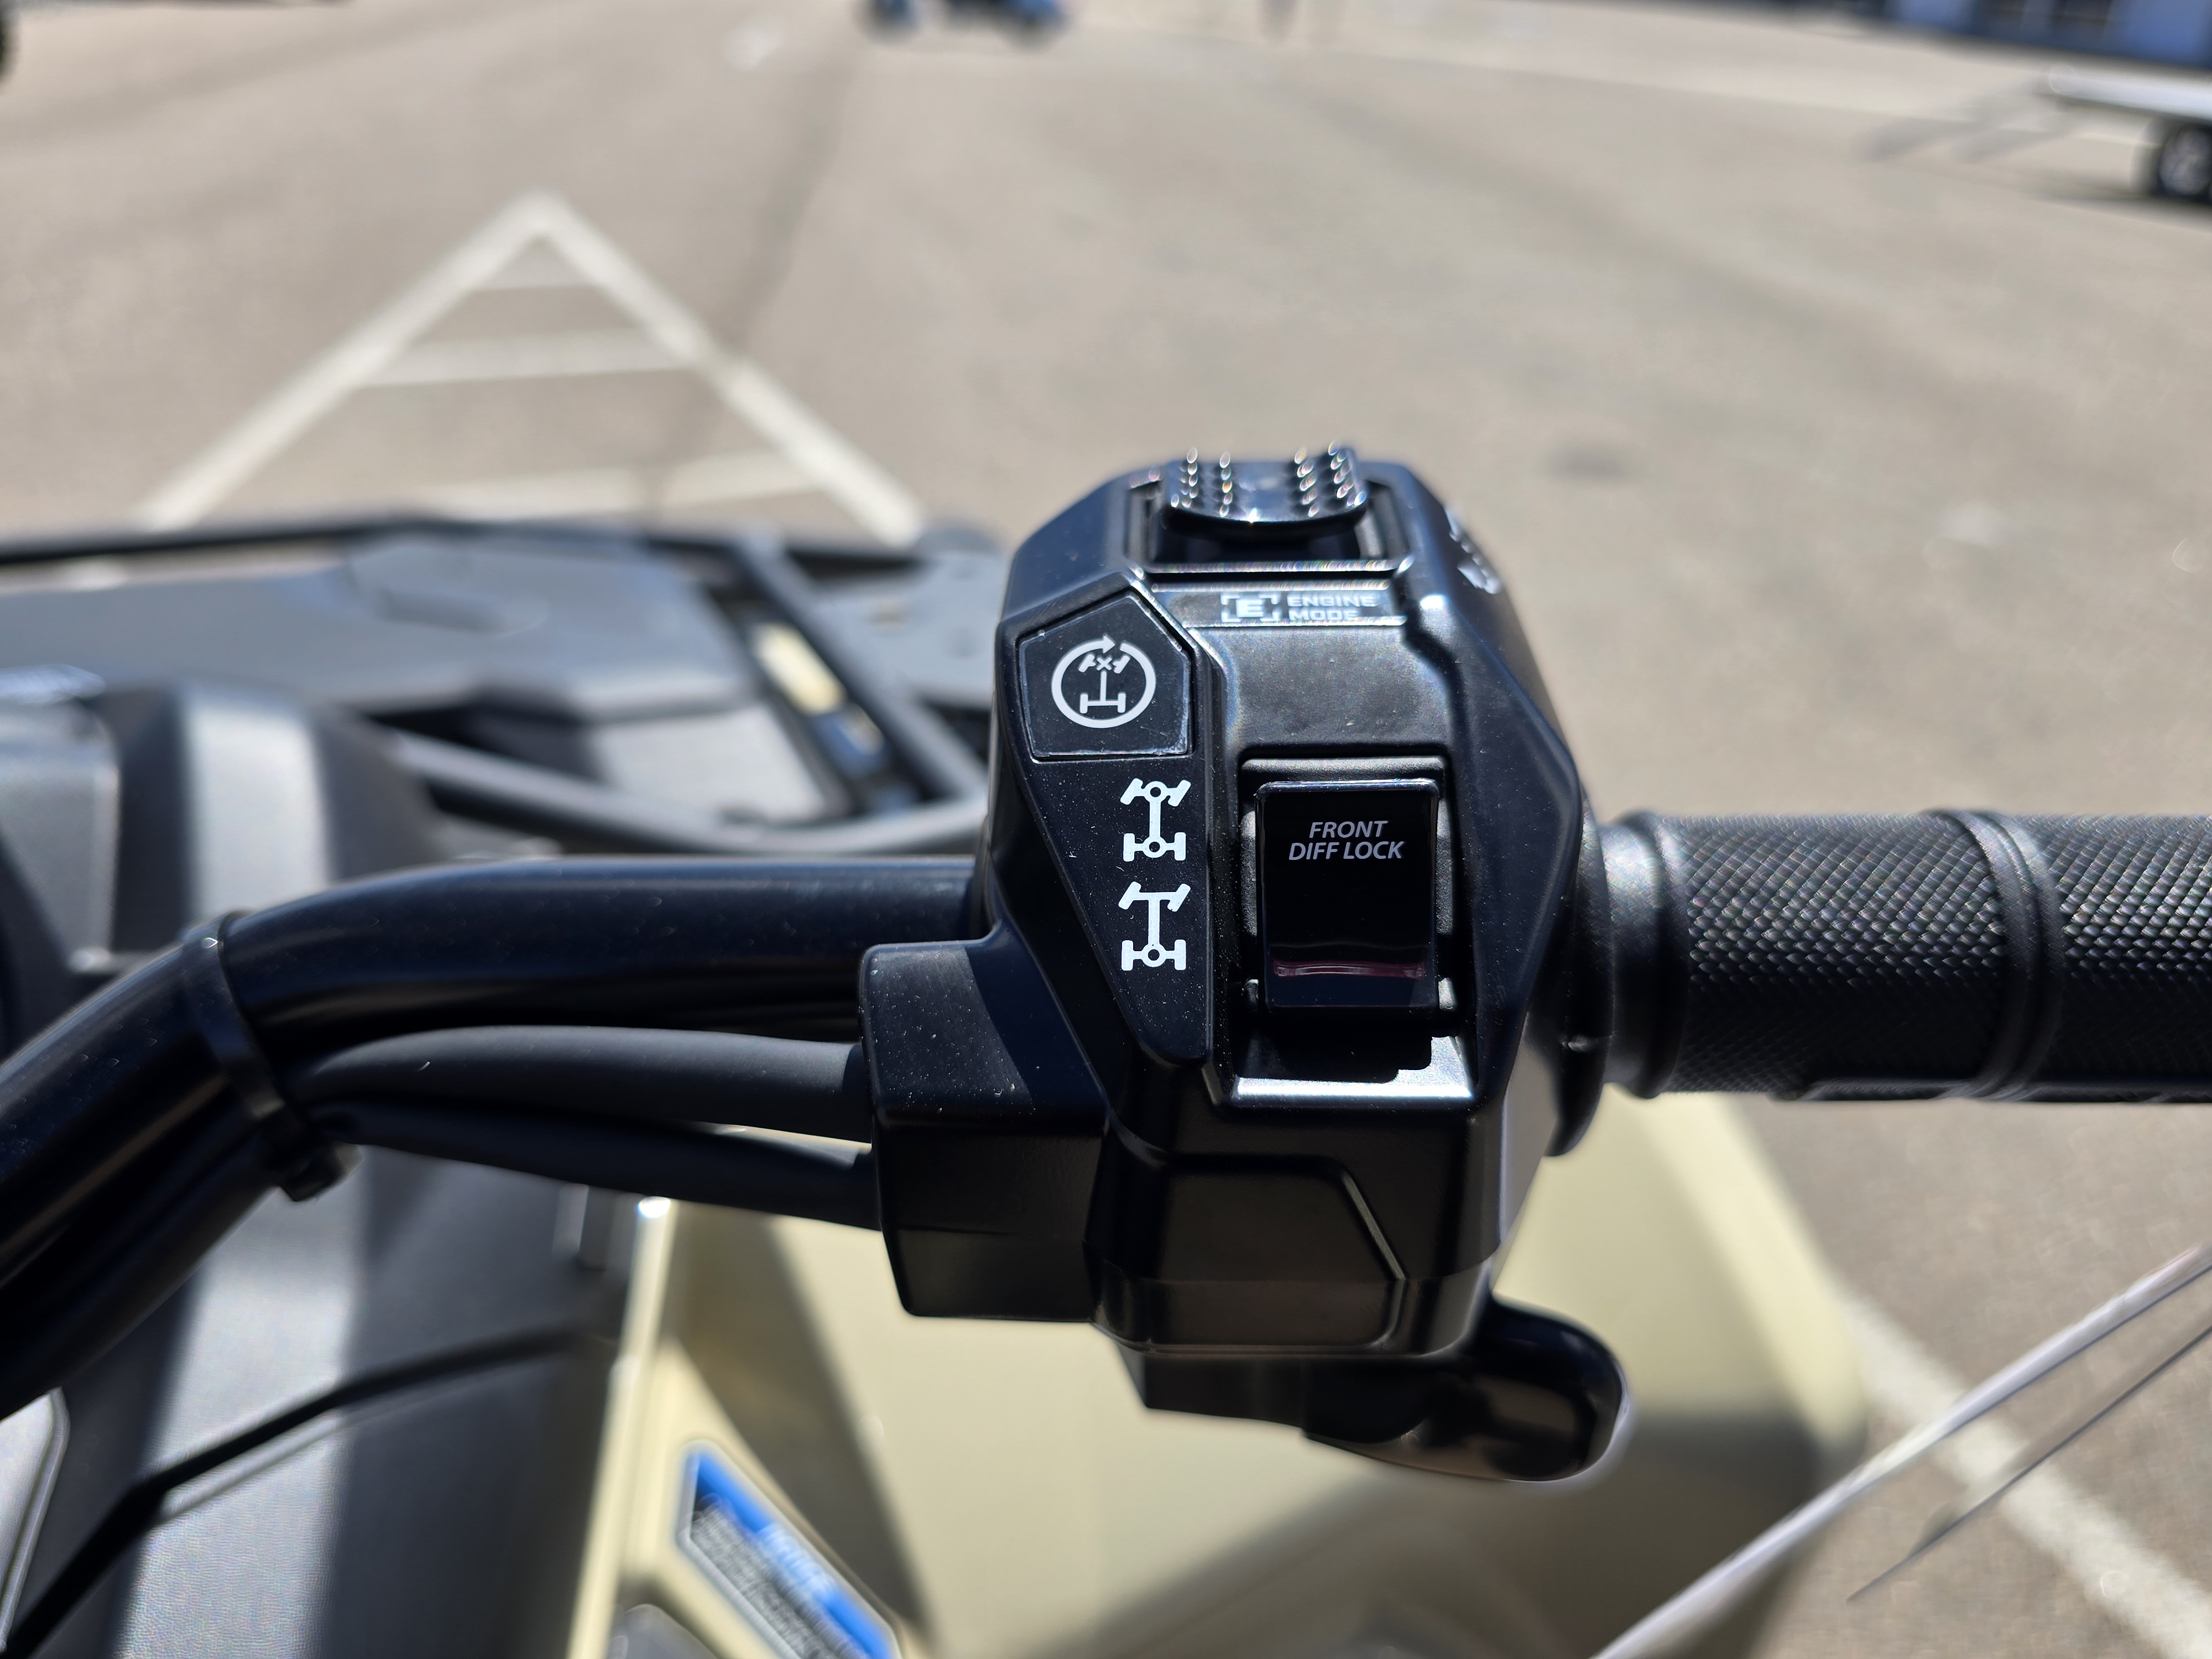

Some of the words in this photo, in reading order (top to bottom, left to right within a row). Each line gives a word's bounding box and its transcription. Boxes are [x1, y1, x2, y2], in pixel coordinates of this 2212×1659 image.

[1287, 594, 1378, 607] ENGINE
[1288, 608, 1361, 621] MODE
[1309, 821, 1388, 838] FRONT
[1288, 842, 1339, 860] DIFF
[1343, 841, 1404, 859] LOCK
